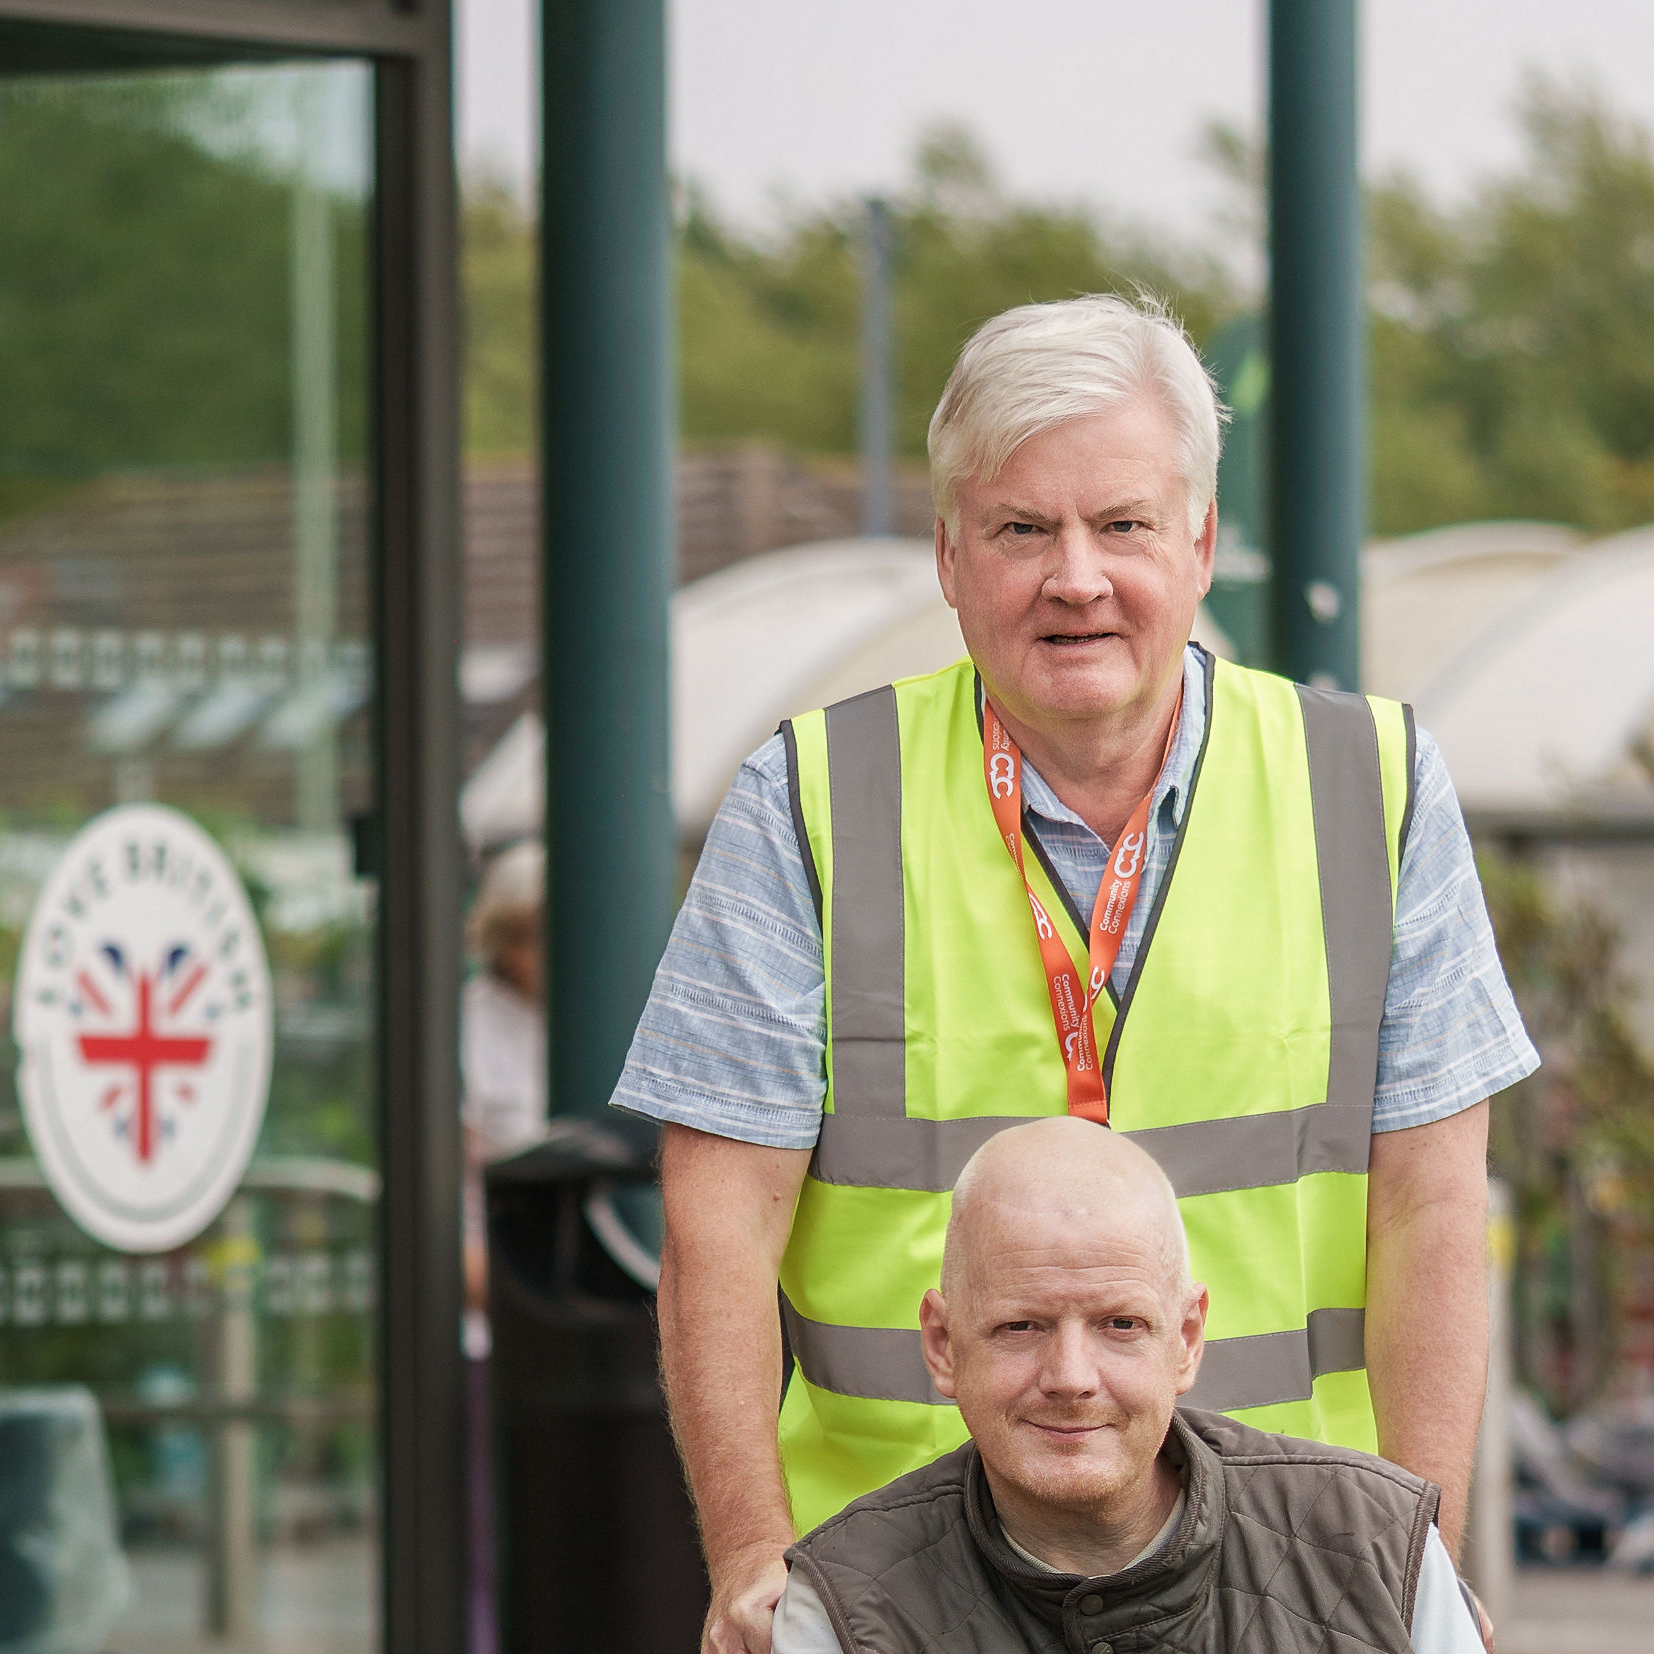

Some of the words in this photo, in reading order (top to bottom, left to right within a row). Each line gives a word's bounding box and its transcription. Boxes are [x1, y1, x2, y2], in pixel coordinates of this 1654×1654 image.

[1099, 879, 1122, 931] Community
[1108, 881, 1131, 935] Connexions
[1053, 976, 1071, 1032] Connexions
[1061, 973, 1080, 1028] Community
